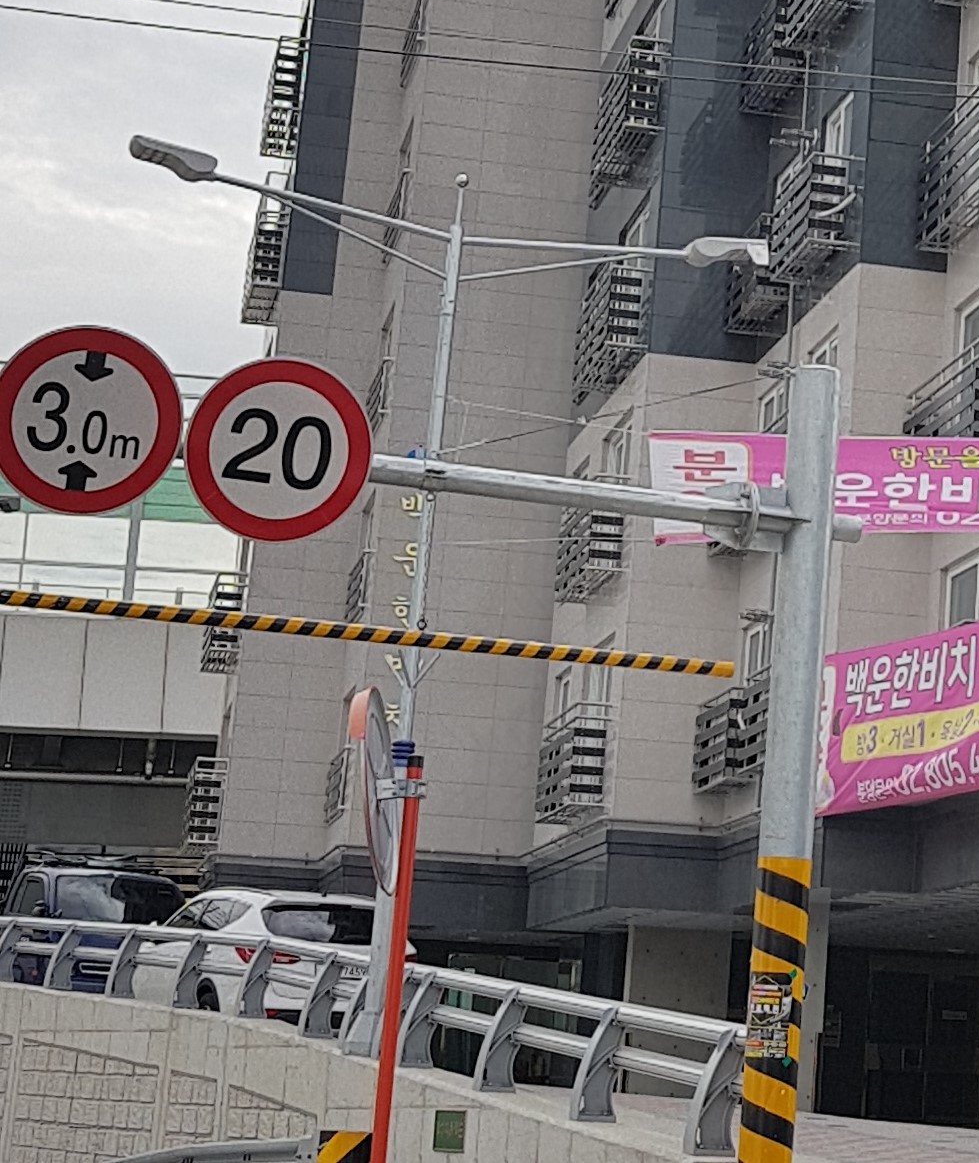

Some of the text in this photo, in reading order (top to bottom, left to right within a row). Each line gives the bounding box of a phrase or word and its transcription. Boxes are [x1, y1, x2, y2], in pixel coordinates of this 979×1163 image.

[27, 382, 140, 460] 3.0m
[222, 408, 332, 490] 20
[845, 641, 976, 716] 백운한비치
